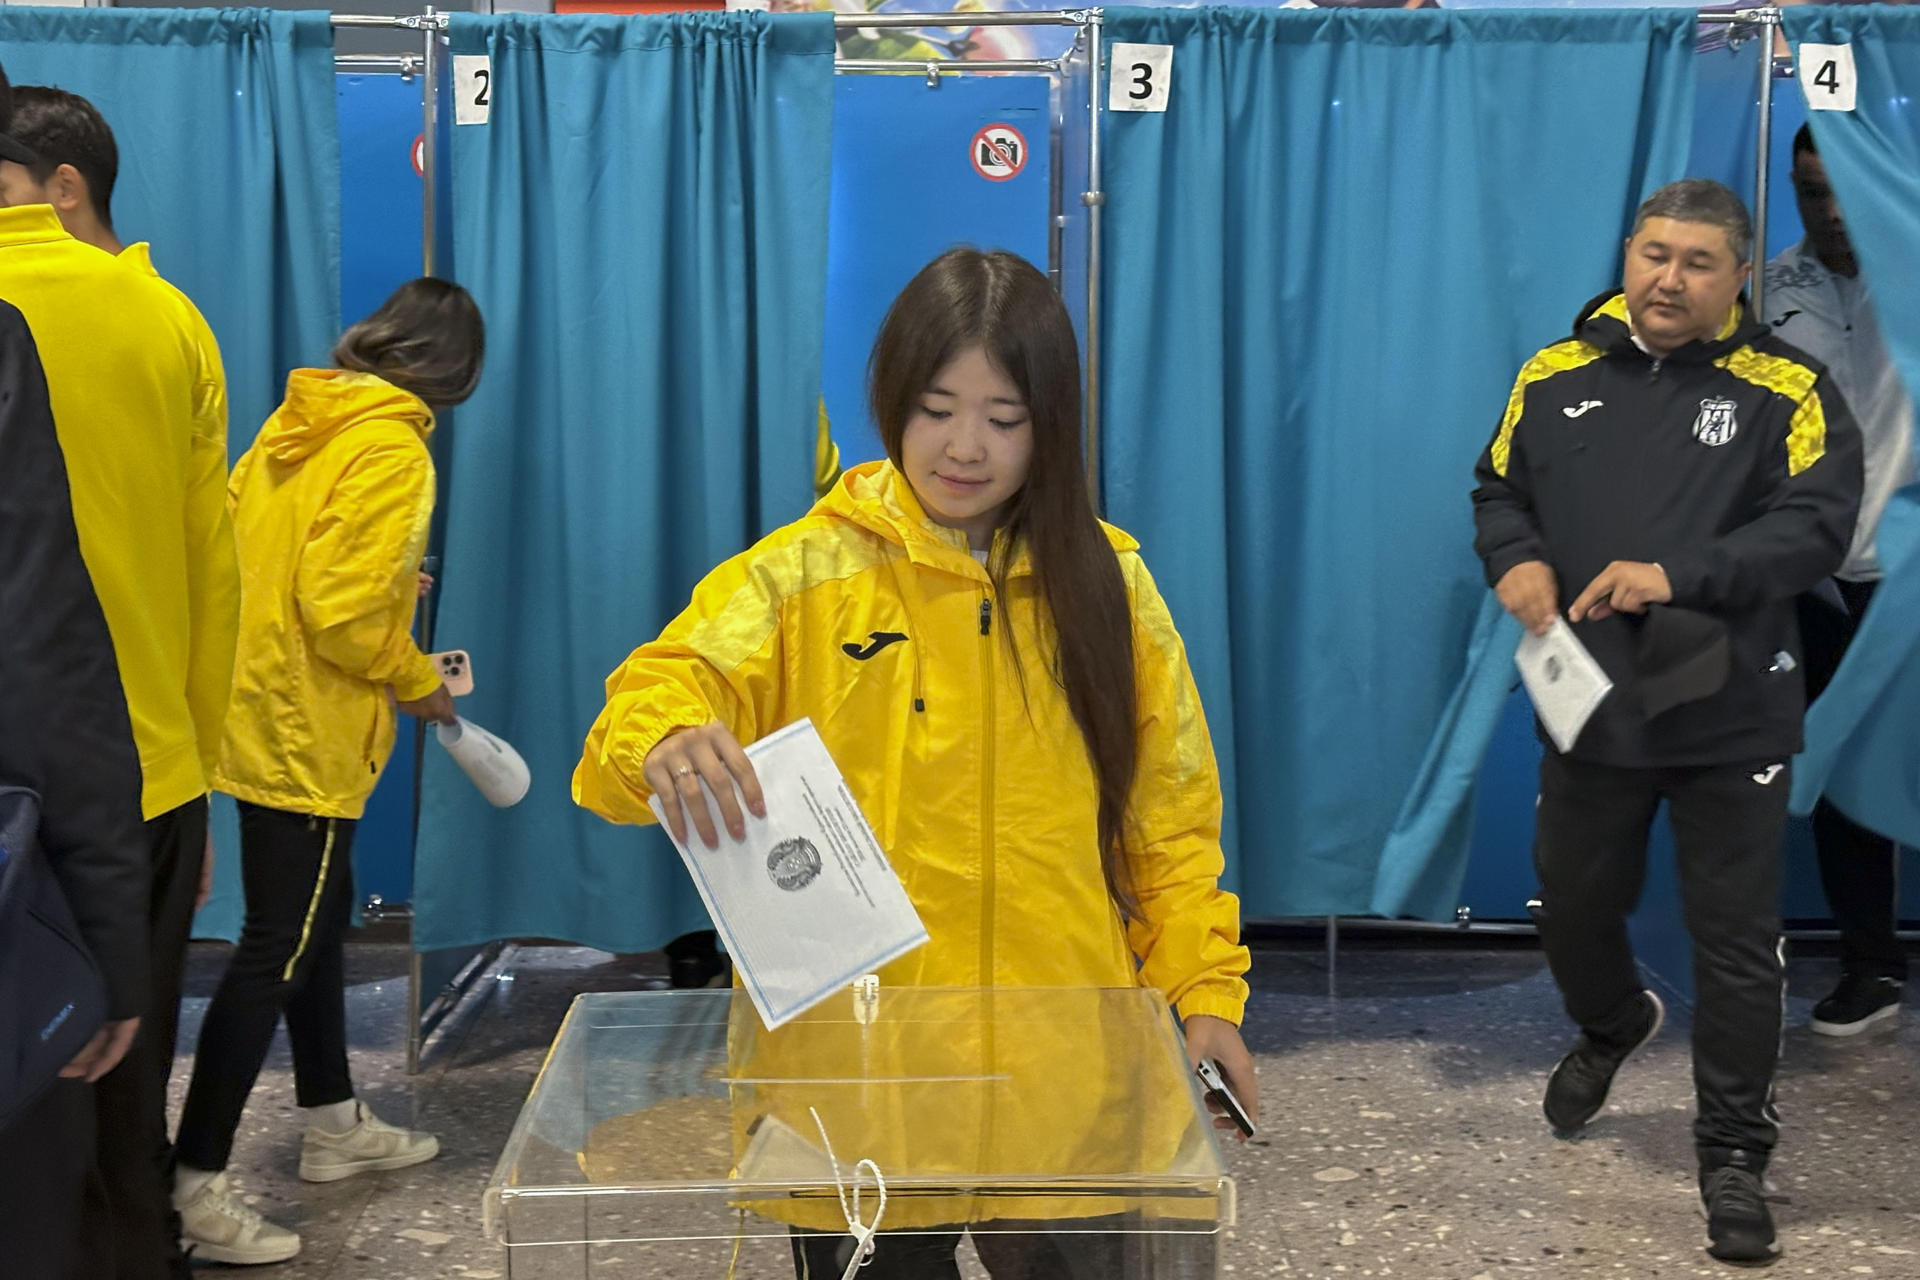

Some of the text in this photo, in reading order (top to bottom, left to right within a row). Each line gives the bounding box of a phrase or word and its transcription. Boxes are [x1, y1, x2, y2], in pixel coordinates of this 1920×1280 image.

[474, 69, 490, 106] 2
[1128, 62, 1153, 100] 3
[1813, 59, 1840, 95] 4
